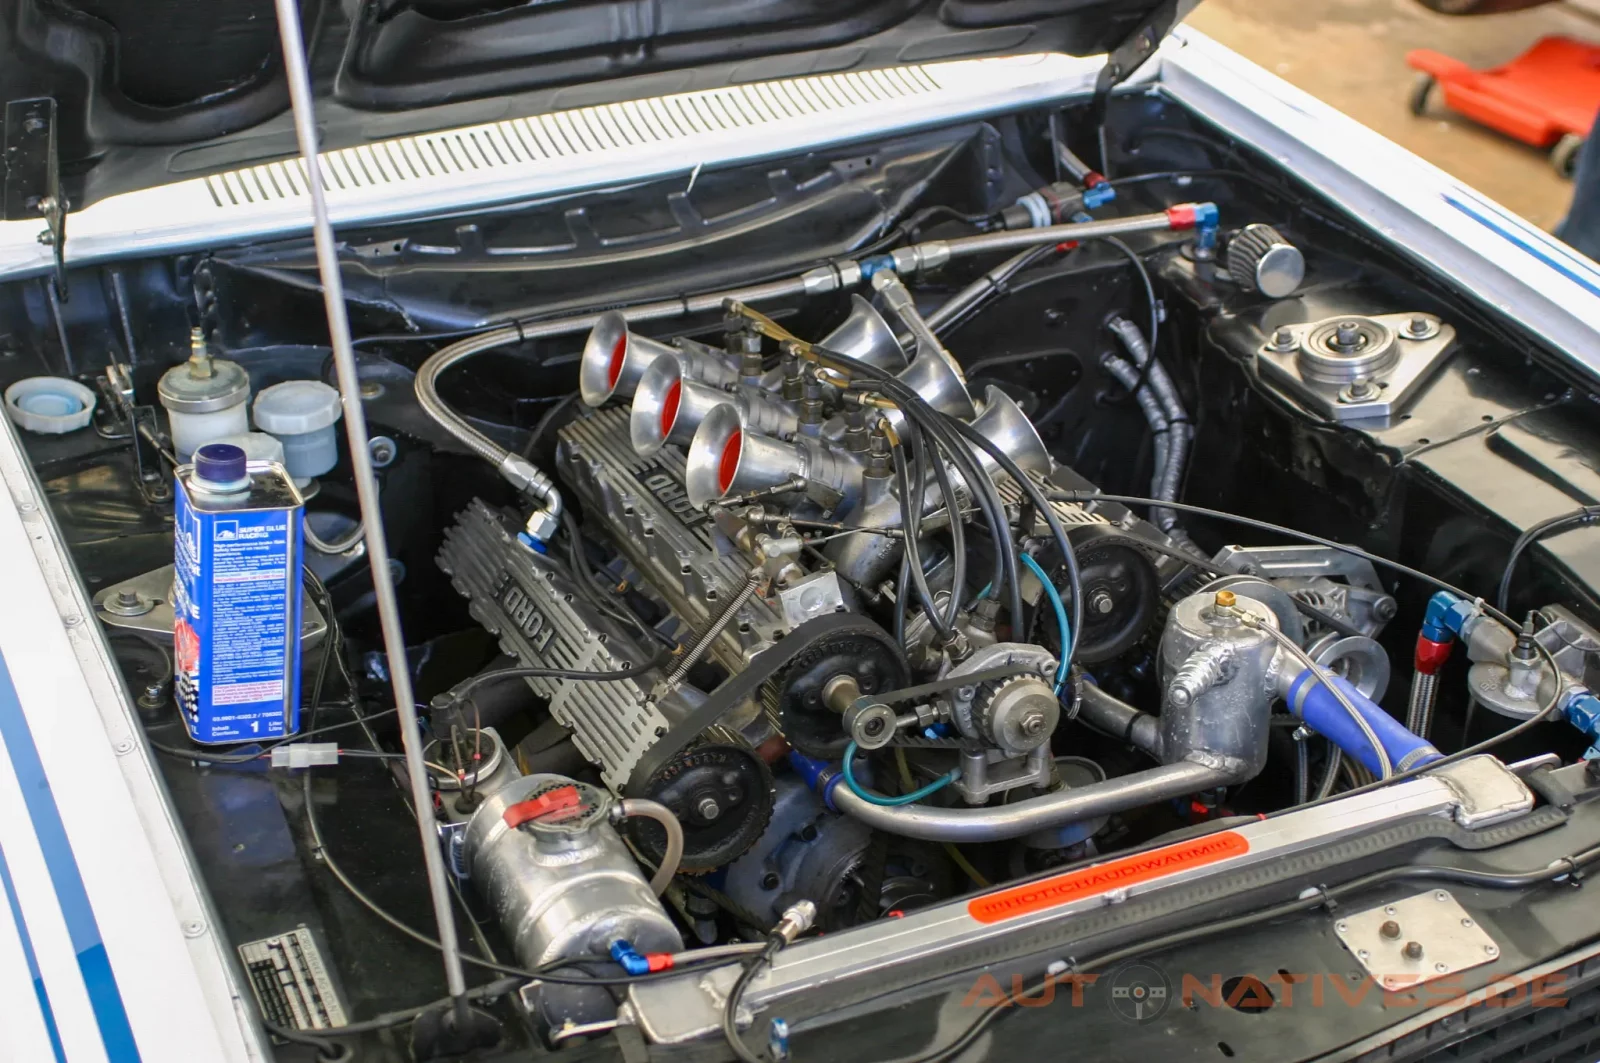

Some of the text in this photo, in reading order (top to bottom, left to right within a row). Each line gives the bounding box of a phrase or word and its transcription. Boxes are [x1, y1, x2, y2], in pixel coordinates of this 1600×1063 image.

[645, 473, 708, 525] FORD
[502, 585, 554, 652] FORD
[250, 721, 259, 733] 1
